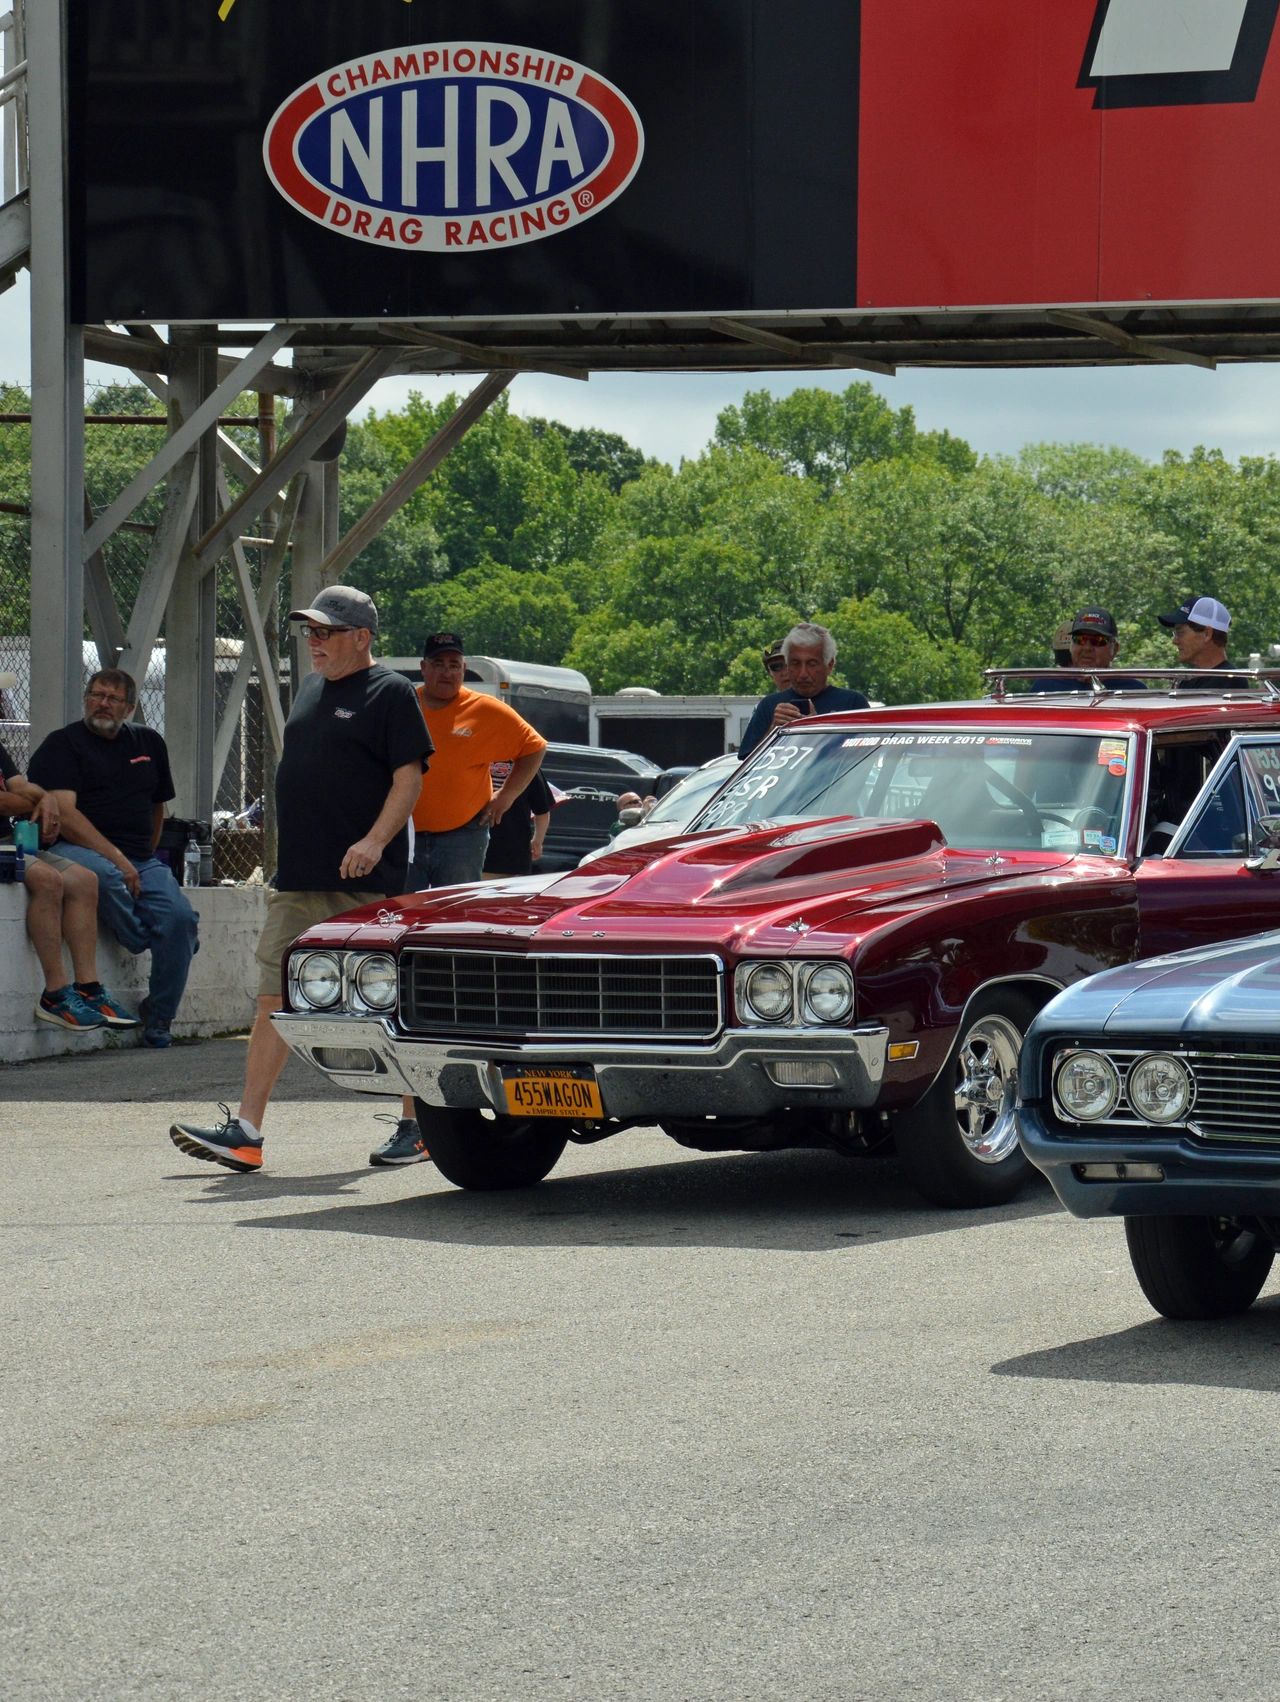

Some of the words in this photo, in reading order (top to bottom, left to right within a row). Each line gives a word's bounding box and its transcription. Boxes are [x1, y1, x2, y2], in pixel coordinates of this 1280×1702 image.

[327, 48, 575, 97] CHAMPIONSHIP
[330, 85, 585, 209] NHRA
[329, 201, 423, 245] DRAG
[445, 199, 571, 246] RACING
[881, 736, 914, 745] DRAG
[917, 736, 952, 744] WEEK
[953, 736, 985, 744] 2019
[524, 1069, 544, 1078] NEW
[549, 1069, 573, 1078] YORK
[514, 1081, 593, 1108] 455WAGON
